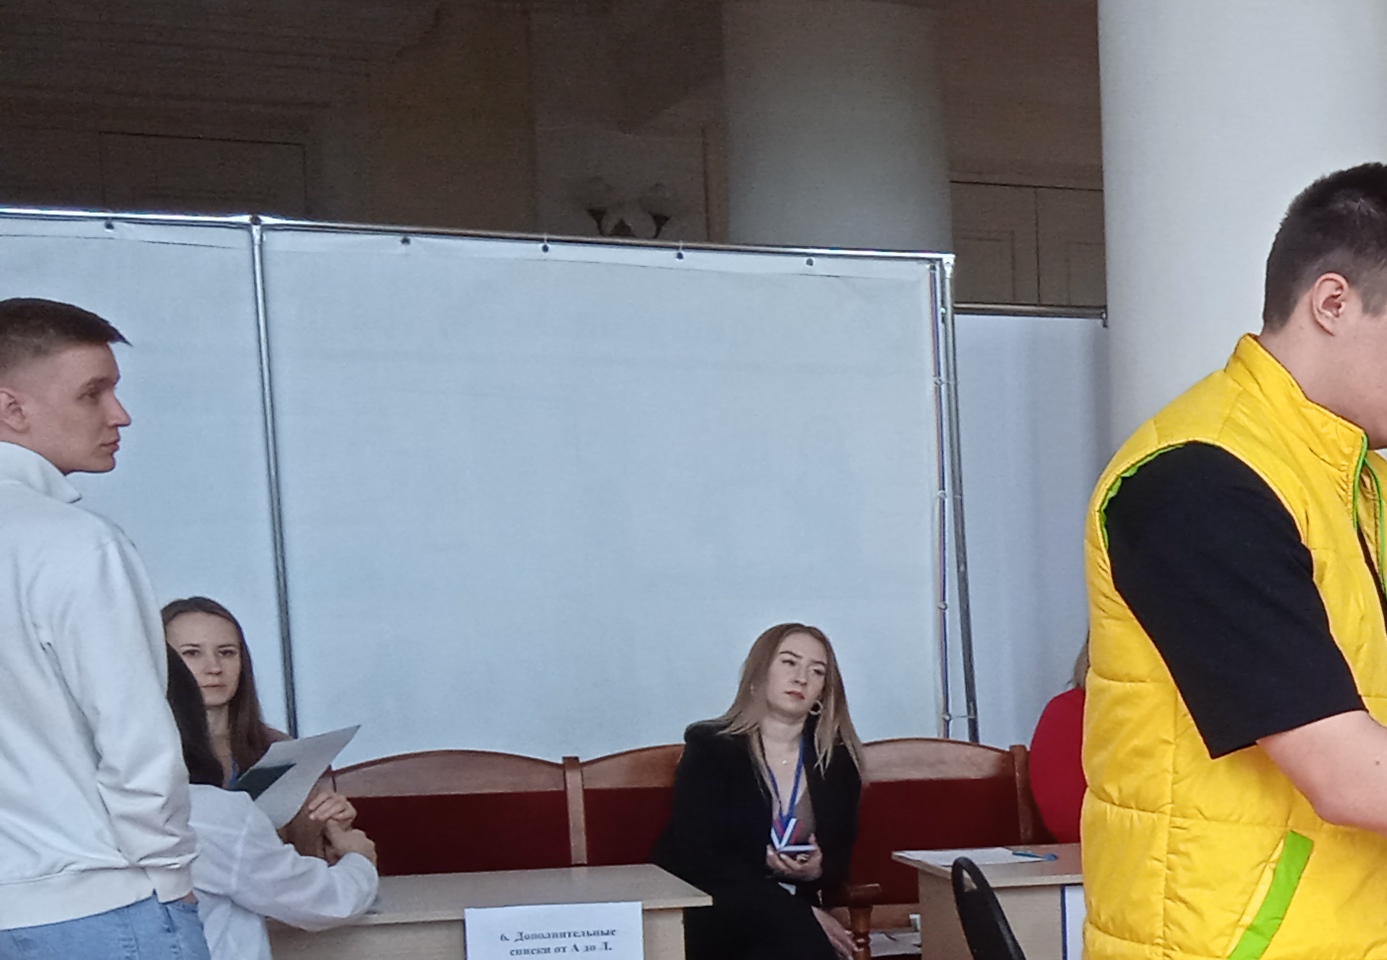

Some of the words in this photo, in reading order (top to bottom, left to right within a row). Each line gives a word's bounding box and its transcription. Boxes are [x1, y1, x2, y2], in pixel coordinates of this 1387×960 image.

[514, 929, 617, 943] Дополнительные
[509, 946, 551, 956] списки
[553, 945, 567, 954] от
[584, 944, 597, 953] до
